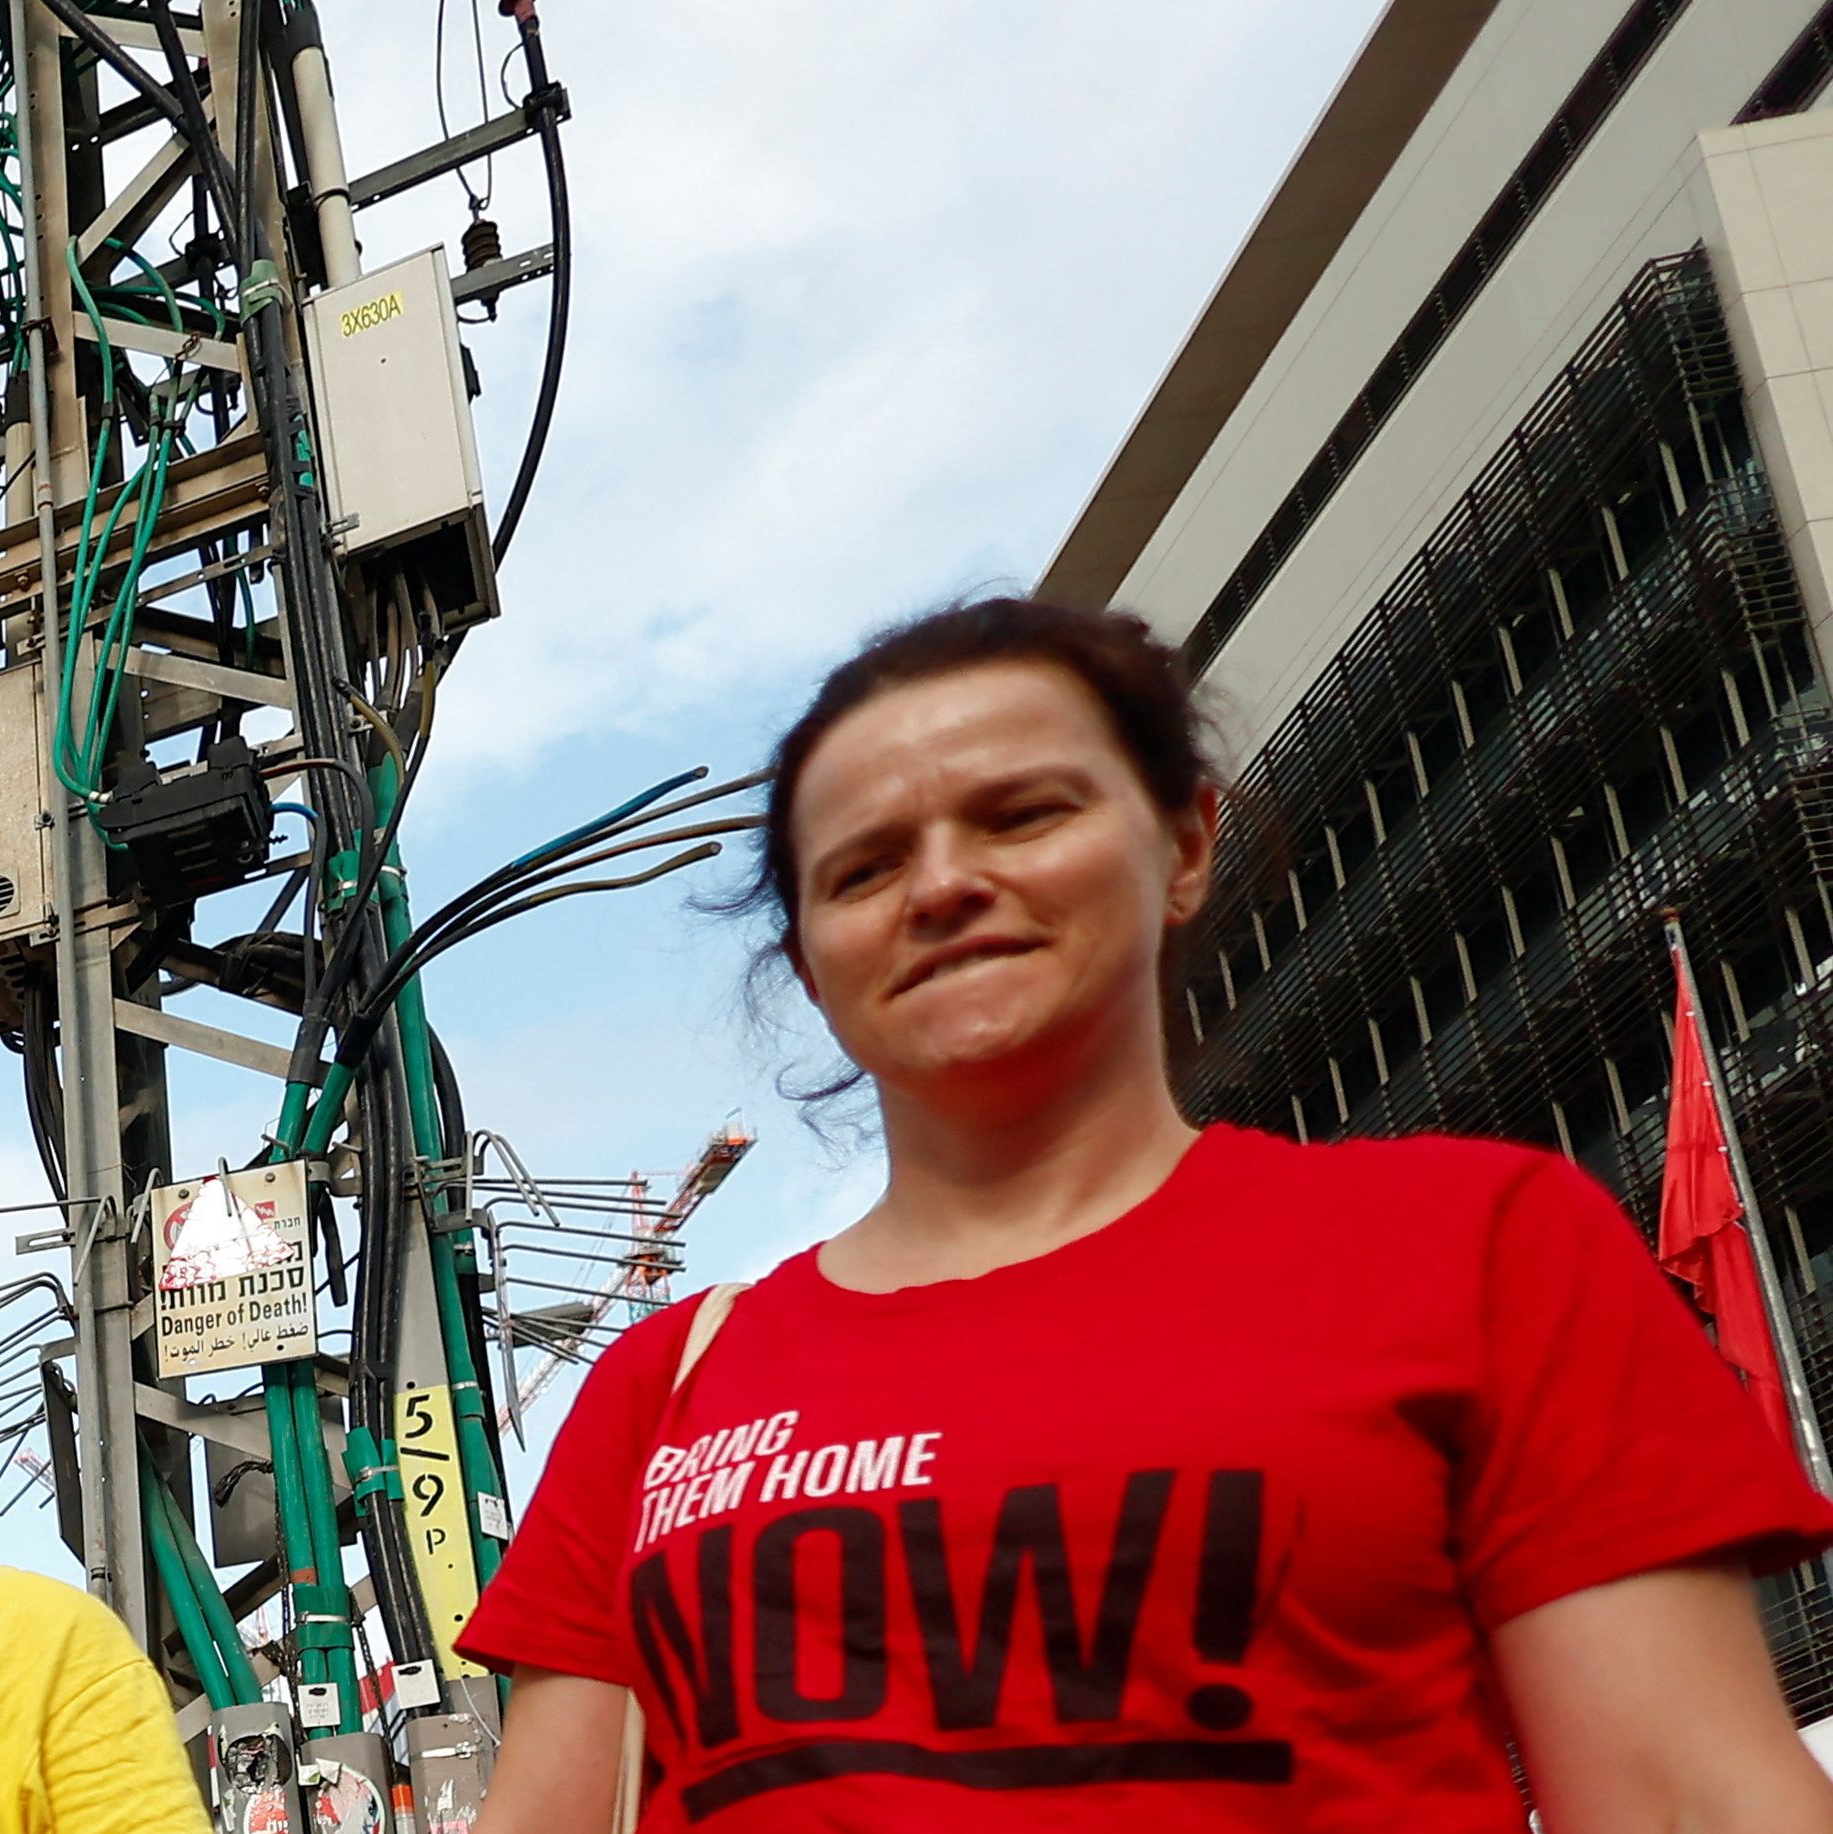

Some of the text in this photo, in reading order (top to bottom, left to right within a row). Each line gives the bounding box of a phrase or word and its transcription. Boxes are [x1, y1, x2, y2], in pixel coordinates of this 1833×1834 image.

[341, 294, 401, 337] 3X630A
[238, 1266, 305, 1298] סכנת
[162, 1292, 308, 1337] Danger of Death!
[276, 1323, 309, 1340] ضغط
[208, 1336, 235, 1358] خطر
[643, 1409, 800, 1491] BRING
[634, 1431, 943, 1554] THEM HOME
[629, 1468, 1265, 1750] NOW!
